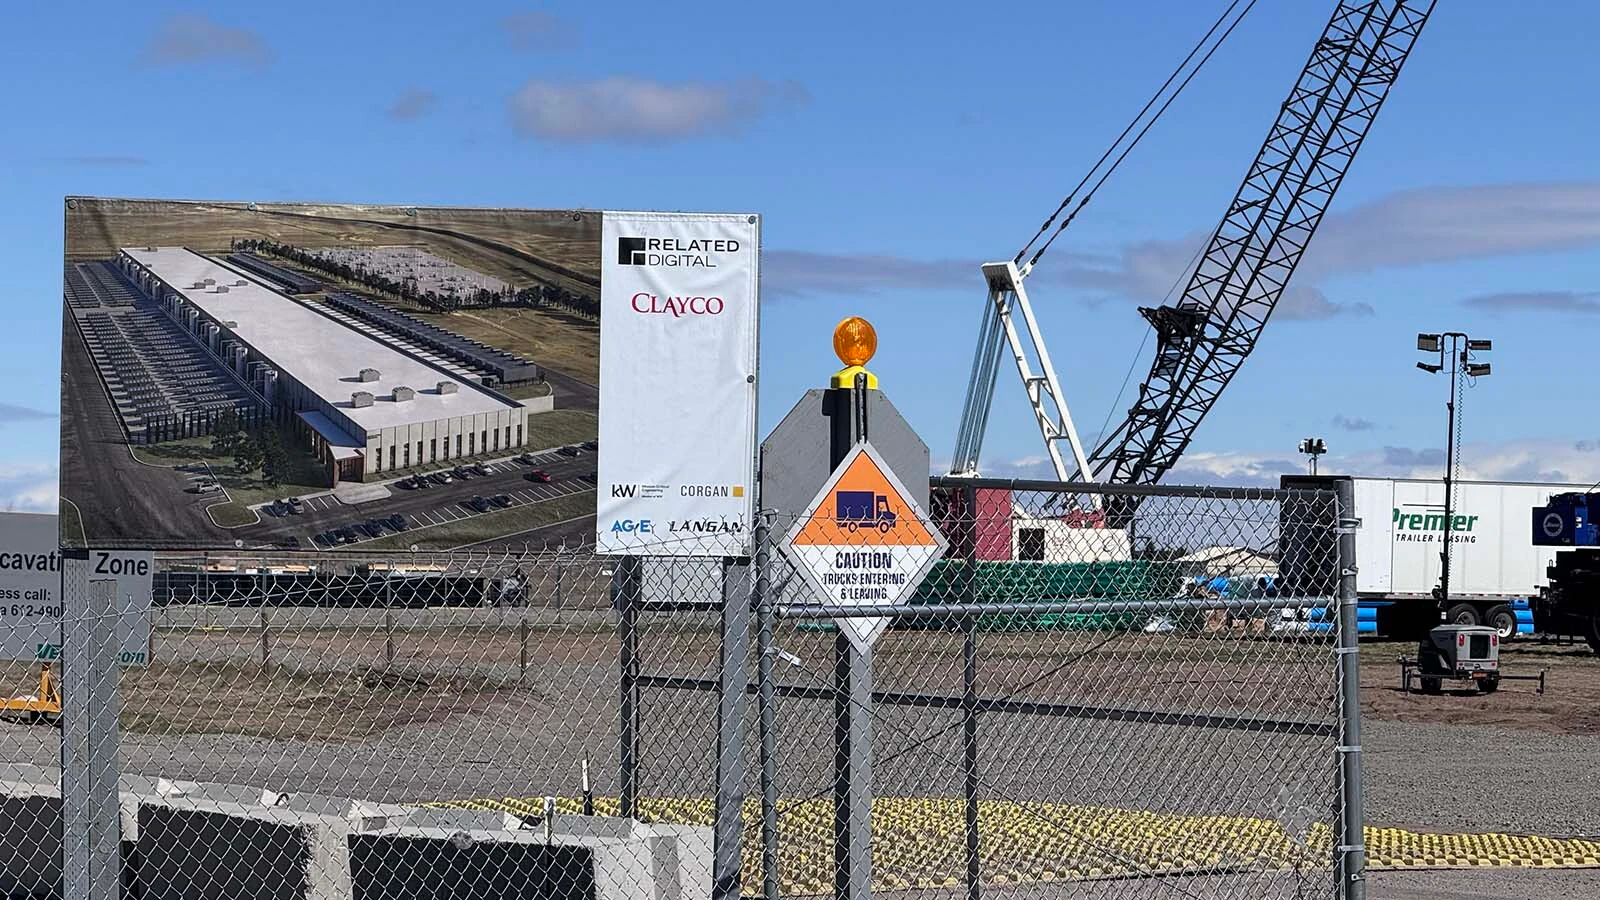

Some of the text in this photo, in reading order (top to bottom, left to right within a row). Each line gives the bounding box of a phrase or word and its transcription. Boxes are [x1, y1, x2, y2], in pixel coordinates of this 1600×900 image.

[649, 239, 739, 252] RELATED
[649, 254, 716, 267] DIGITAL
[631, 292, 724, 317] CLAYCO
[681, 485, 728, 497] CORGAN
[1393, 507, 1479, 532] remer
[669, 520, 742, 533] LANGAN
[1396, 533, 1476, 543] TRAILER LASING
[95, 552, 149, 576] Zone
[835, 552, 892, 569] CAUTION
[823, 573, 905, 585] TRUCKS ENTERING
[24, 588, 51, 601] call:
[840, 588, 887, 600] & LEAVING
